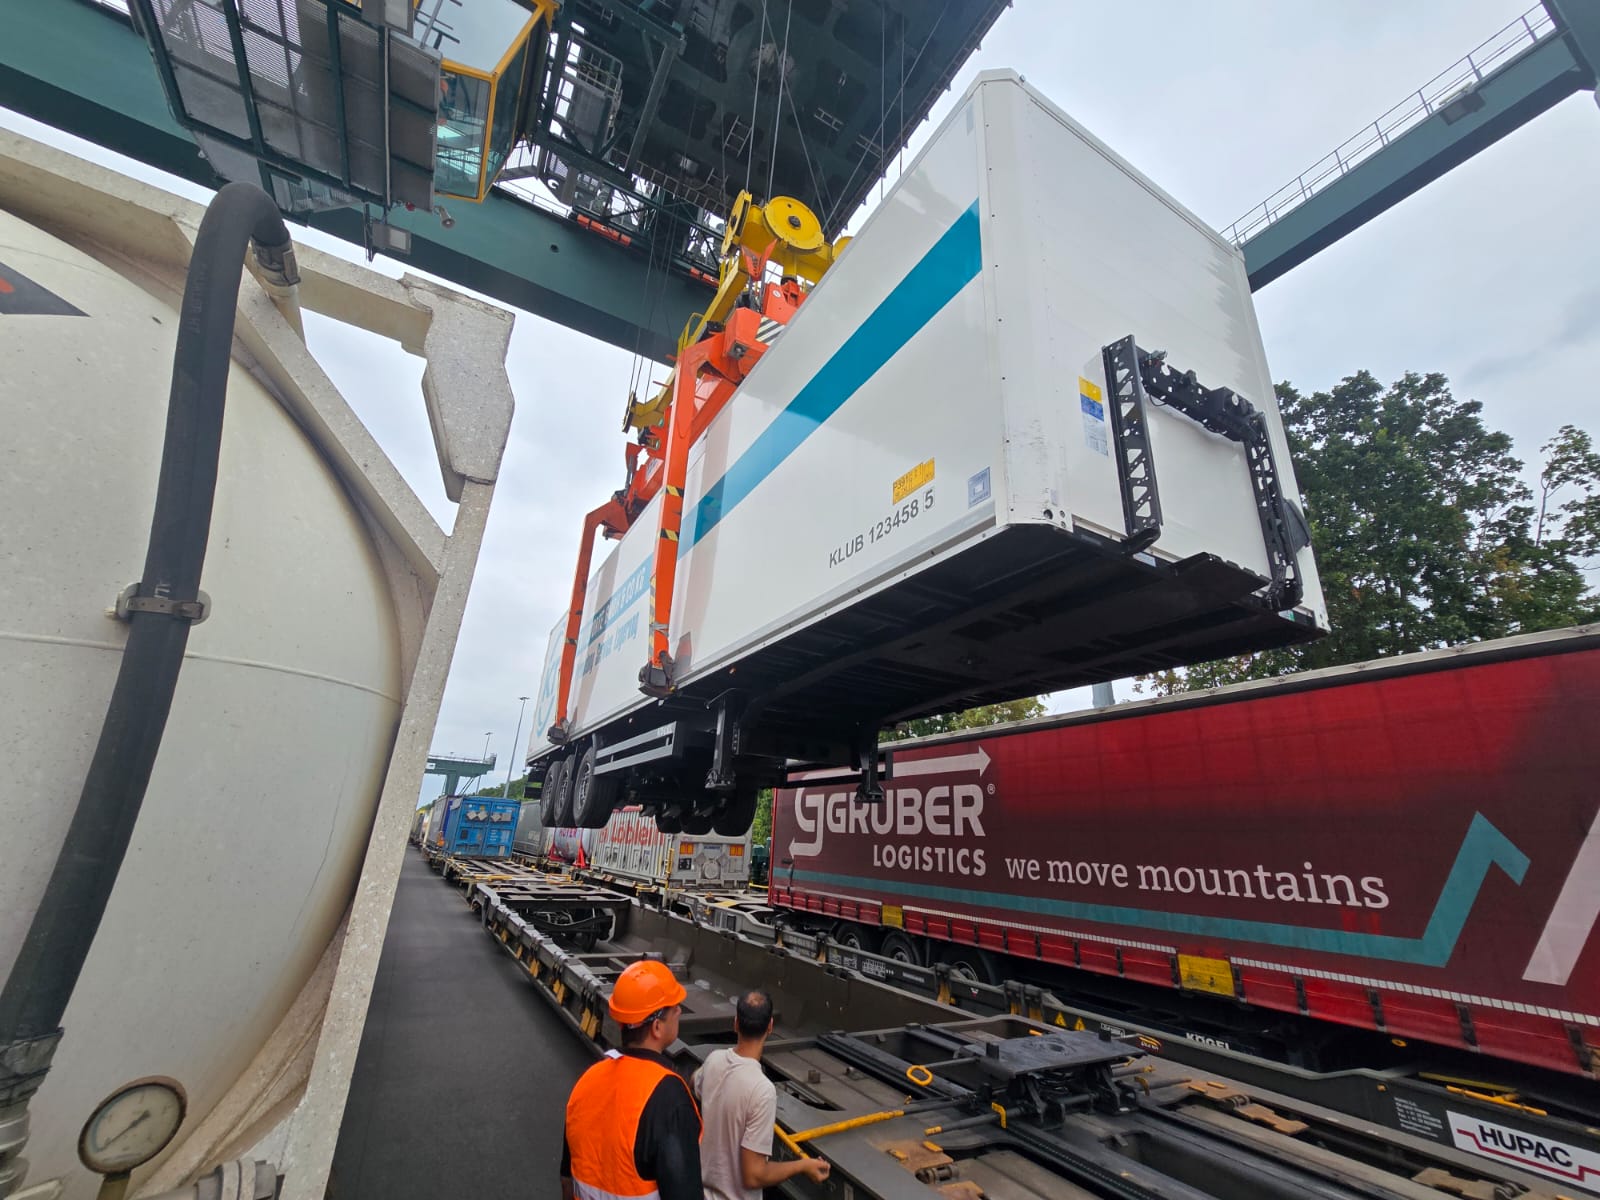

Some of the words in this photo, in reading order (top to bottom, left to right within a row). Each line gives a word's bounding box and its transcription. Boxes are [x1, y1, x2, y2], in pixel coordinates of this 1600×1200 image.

[829, 534, 864, 569] KLUB
[868, 499, 919, 544] 123458
[924, 488, 934, 510] 5
[826, 784, 986, 837] GRUBER
[873, 844, 987, 877] LOGISTICS
[1005, 857, 1041, 881] we
[1047, 858, 1129, 888] move
[1136, 861, 1390, 909] mountains
[1478, 1124, 1573, 1167] HUPAC
